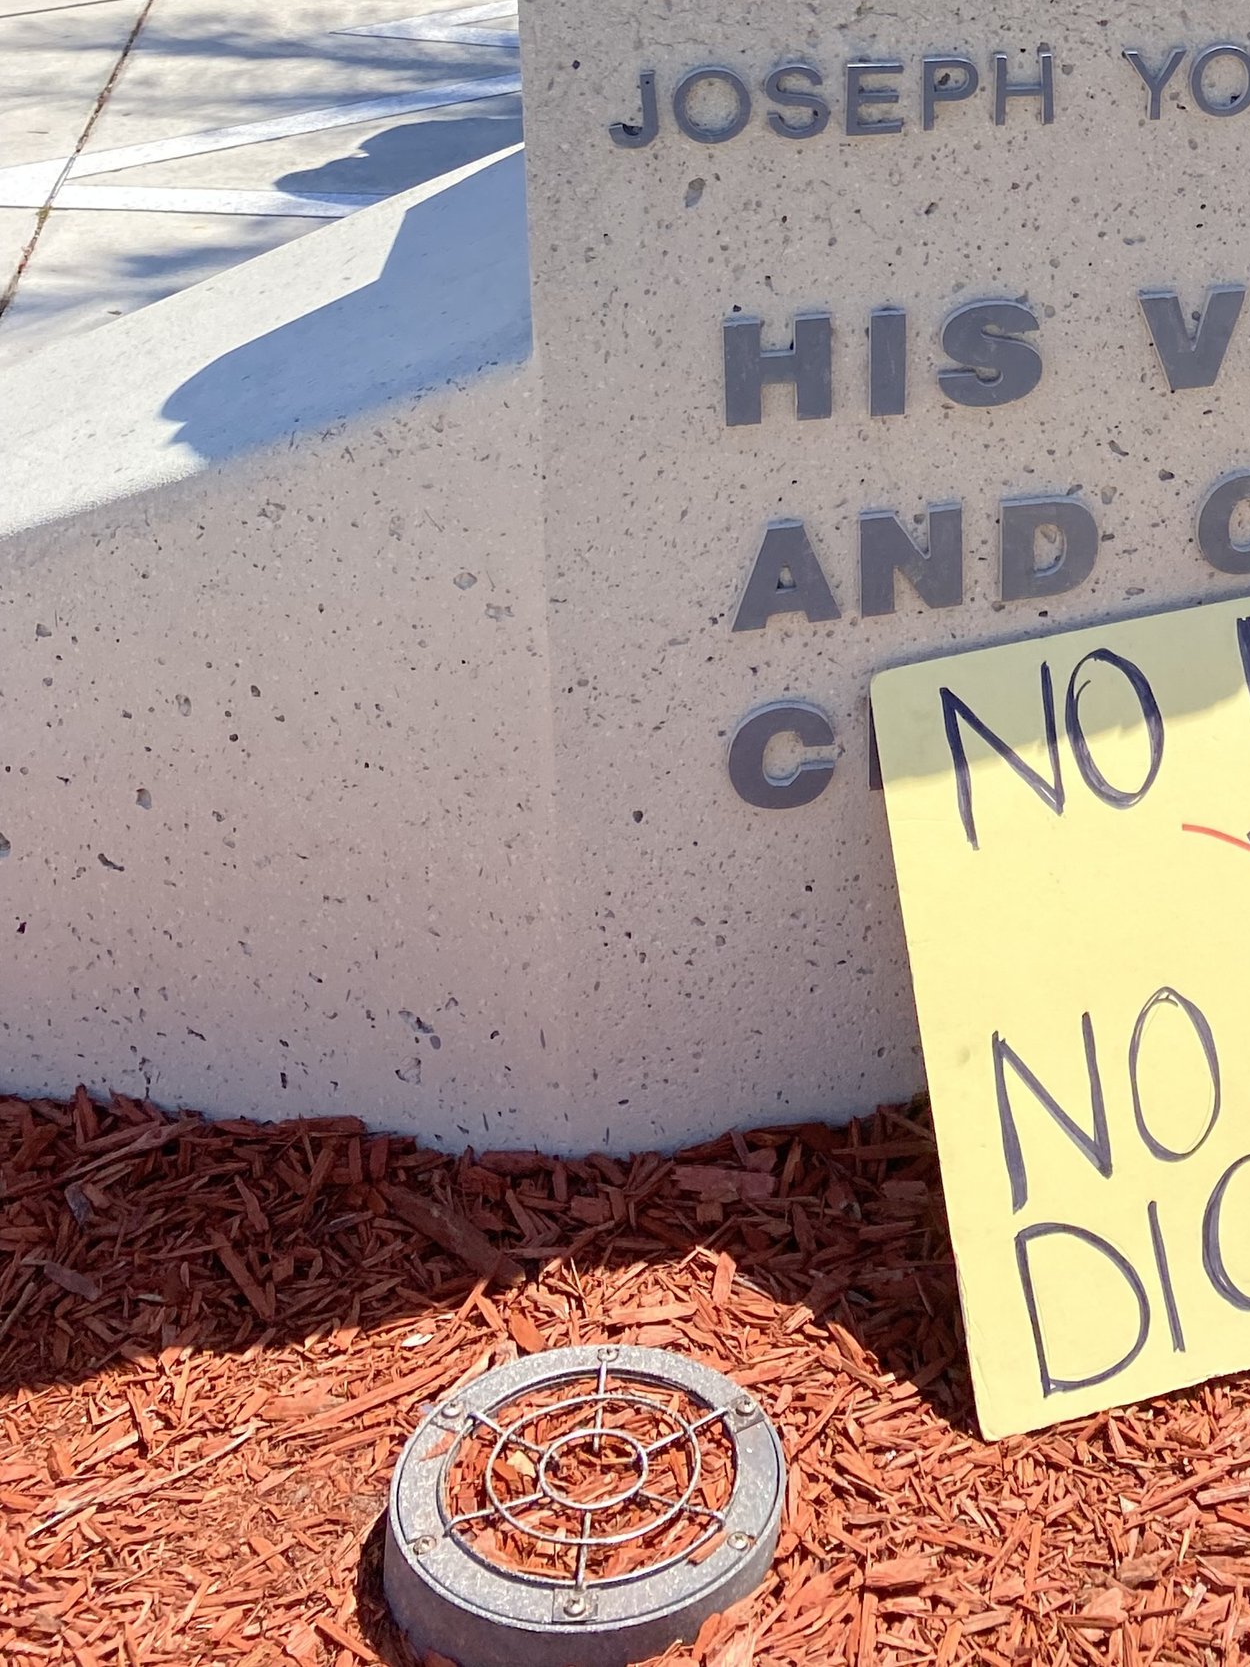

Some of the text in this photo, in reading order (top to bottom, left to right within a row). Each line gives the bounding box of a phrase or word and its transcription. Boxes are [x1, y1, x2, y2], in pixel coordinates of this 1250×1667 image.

[608, 40, 1056, 149] JOSEPH
[722, 297, 1044, 426] HIS
[730, 494, 1100, 633] AND
[938, 646, 1165, 851] NO
[991, 984, 1222, 1214] NO
